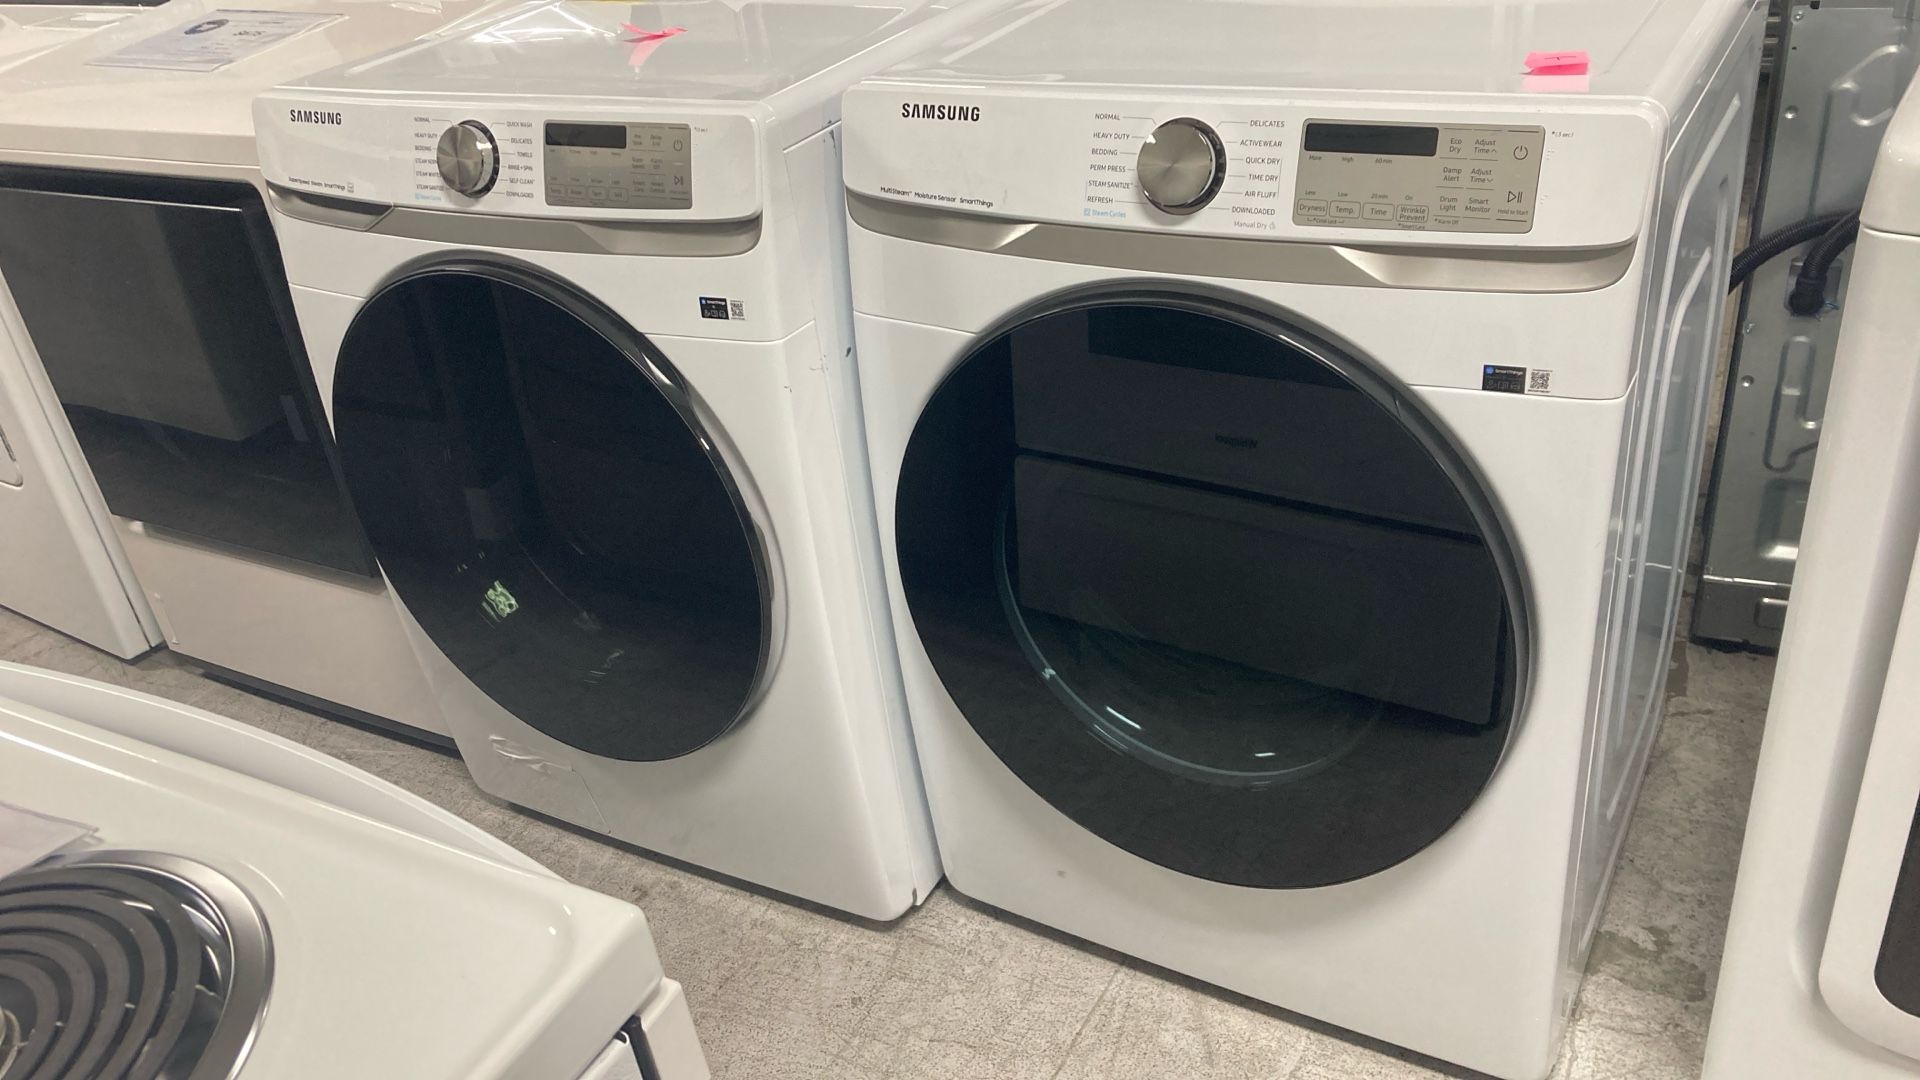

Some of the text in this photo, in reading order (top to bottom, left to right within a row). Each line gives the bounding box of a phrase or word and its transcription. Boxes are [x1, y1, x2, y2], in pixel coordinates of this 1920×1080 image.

[902, 103, 980, 121] SAMSUNG
[290, 109, 342, 125] SAMSUNG
[1240, 139, 1282, 147] ACTIVEWEAR
[1475, 139, 1496, 147] Adjust
[1091, 148, 1118, 156] BEDDING
[1449, 145, 1461, 154] Dry
[1245, 156, 1280, 165] QUICK DRY
[1443, 167, 1462, 175] Damp
[1471, 168, 1492, 176] Adjust
[1265, 174, 1278, 182] DRY
[1244, 190, 1256, 198] AIR
[914, 191, 937, 201] Moisture
[938, 194, 957, 203] Sensor
[959, 197, 994, 209] SmartThings
[1087, 195, 1113, 204] REFRESH
[1468, 197, 1489, 205] Smart
[1232, 206, 1275, 215] DOWNLOADED
[1299, 204, 1326, 213] Dryness
[1371, 207, 1387, 216] Time
[1400, 206, 1426, 214] Wrinkle
[1440, 203, 1456, 212] Light
[1464, 205, 1491, 213] Monitor
[1399, 213, 1425, 221] Prevent
[1234, 220, 1268, 230] Manual Dry
